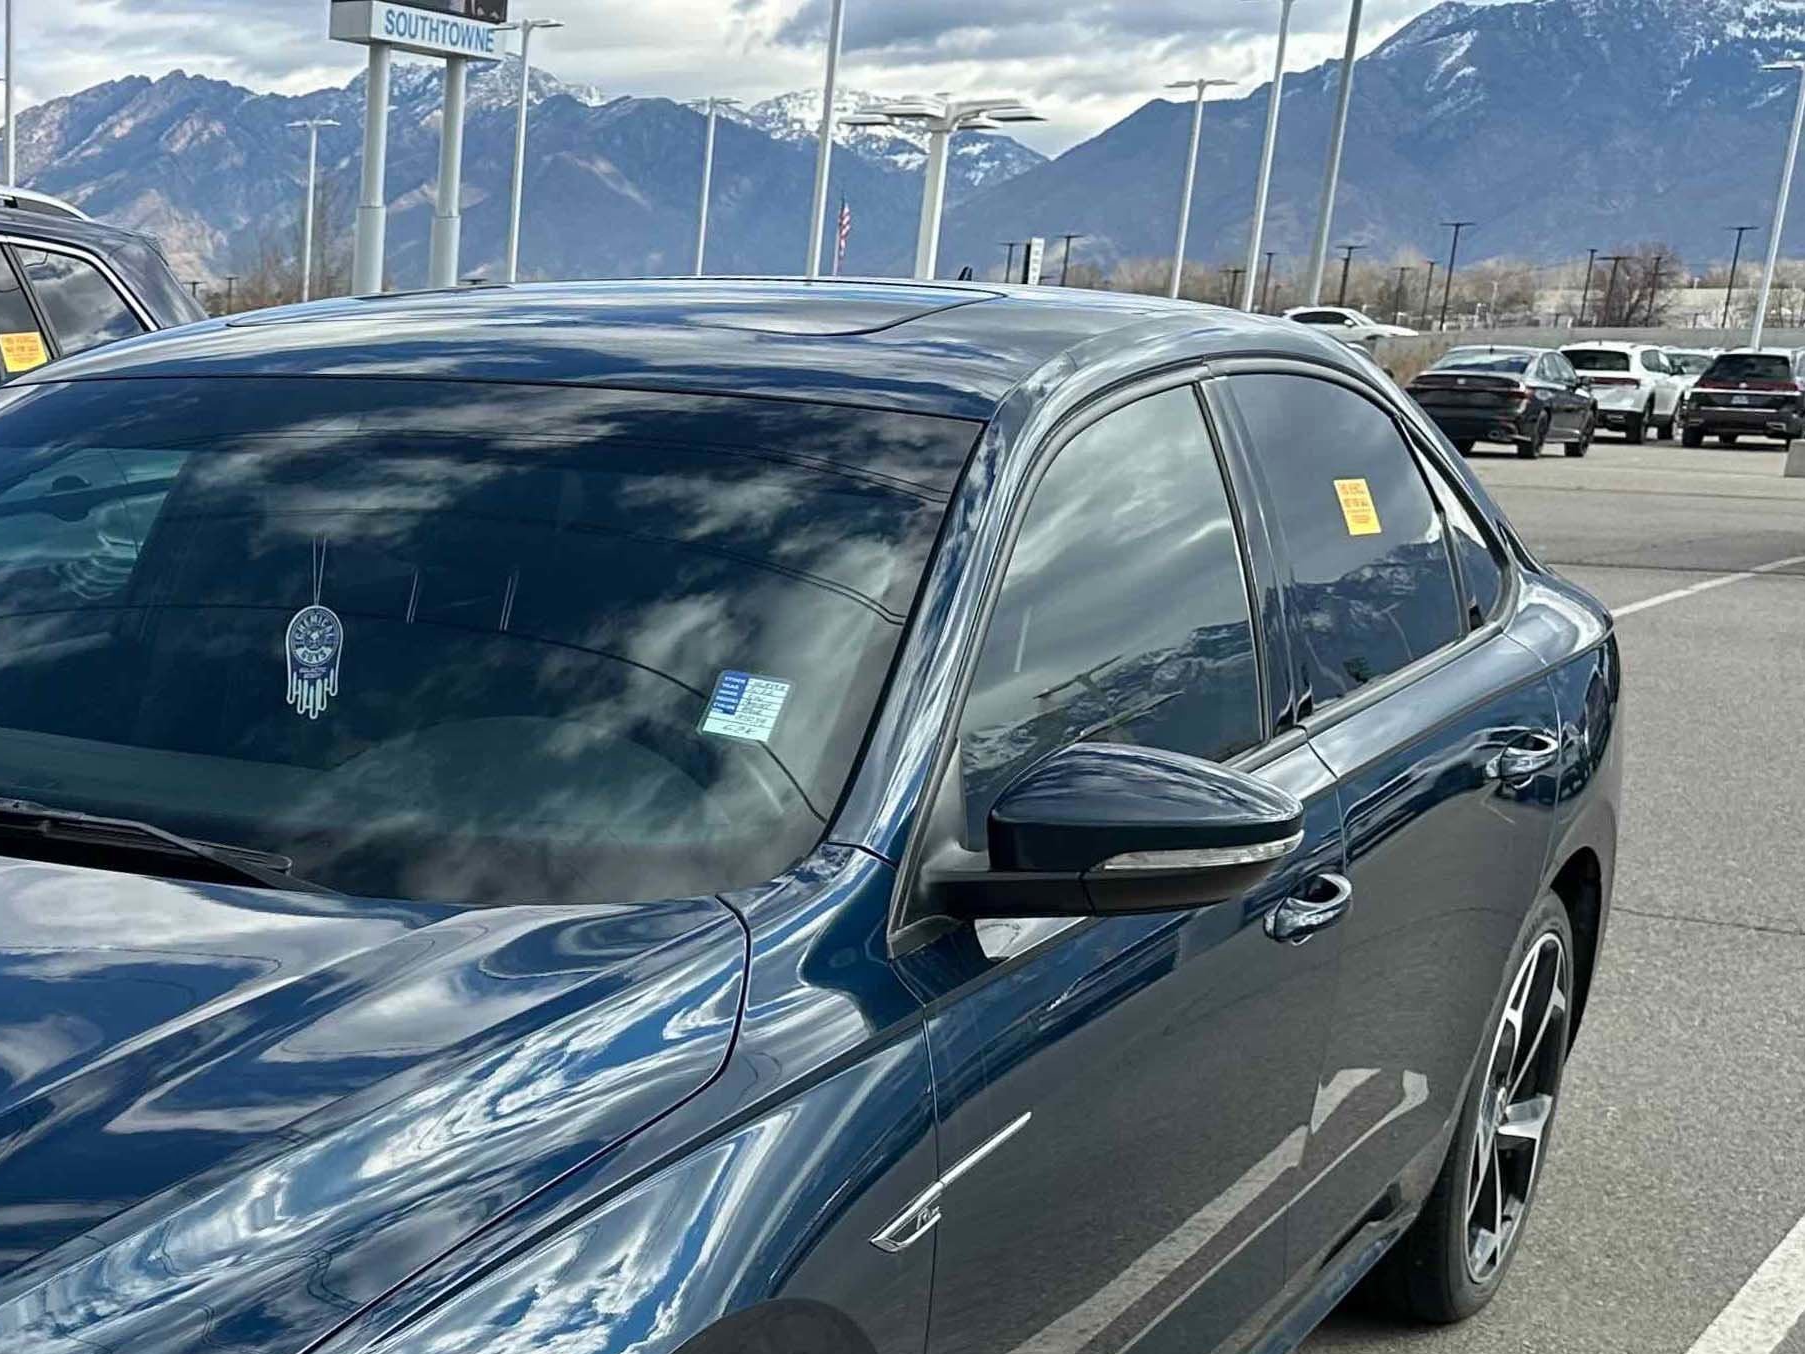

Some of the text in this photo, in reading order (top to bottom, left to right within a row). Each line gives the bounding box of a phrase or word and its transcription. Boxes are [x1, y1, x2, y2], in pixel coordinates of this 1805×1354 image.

[385, 9, 495, 52] SOUTHTOWNE
[295, 614, 335, 642] CHEMICAL
[300, 649, 327, 662] GUYS
